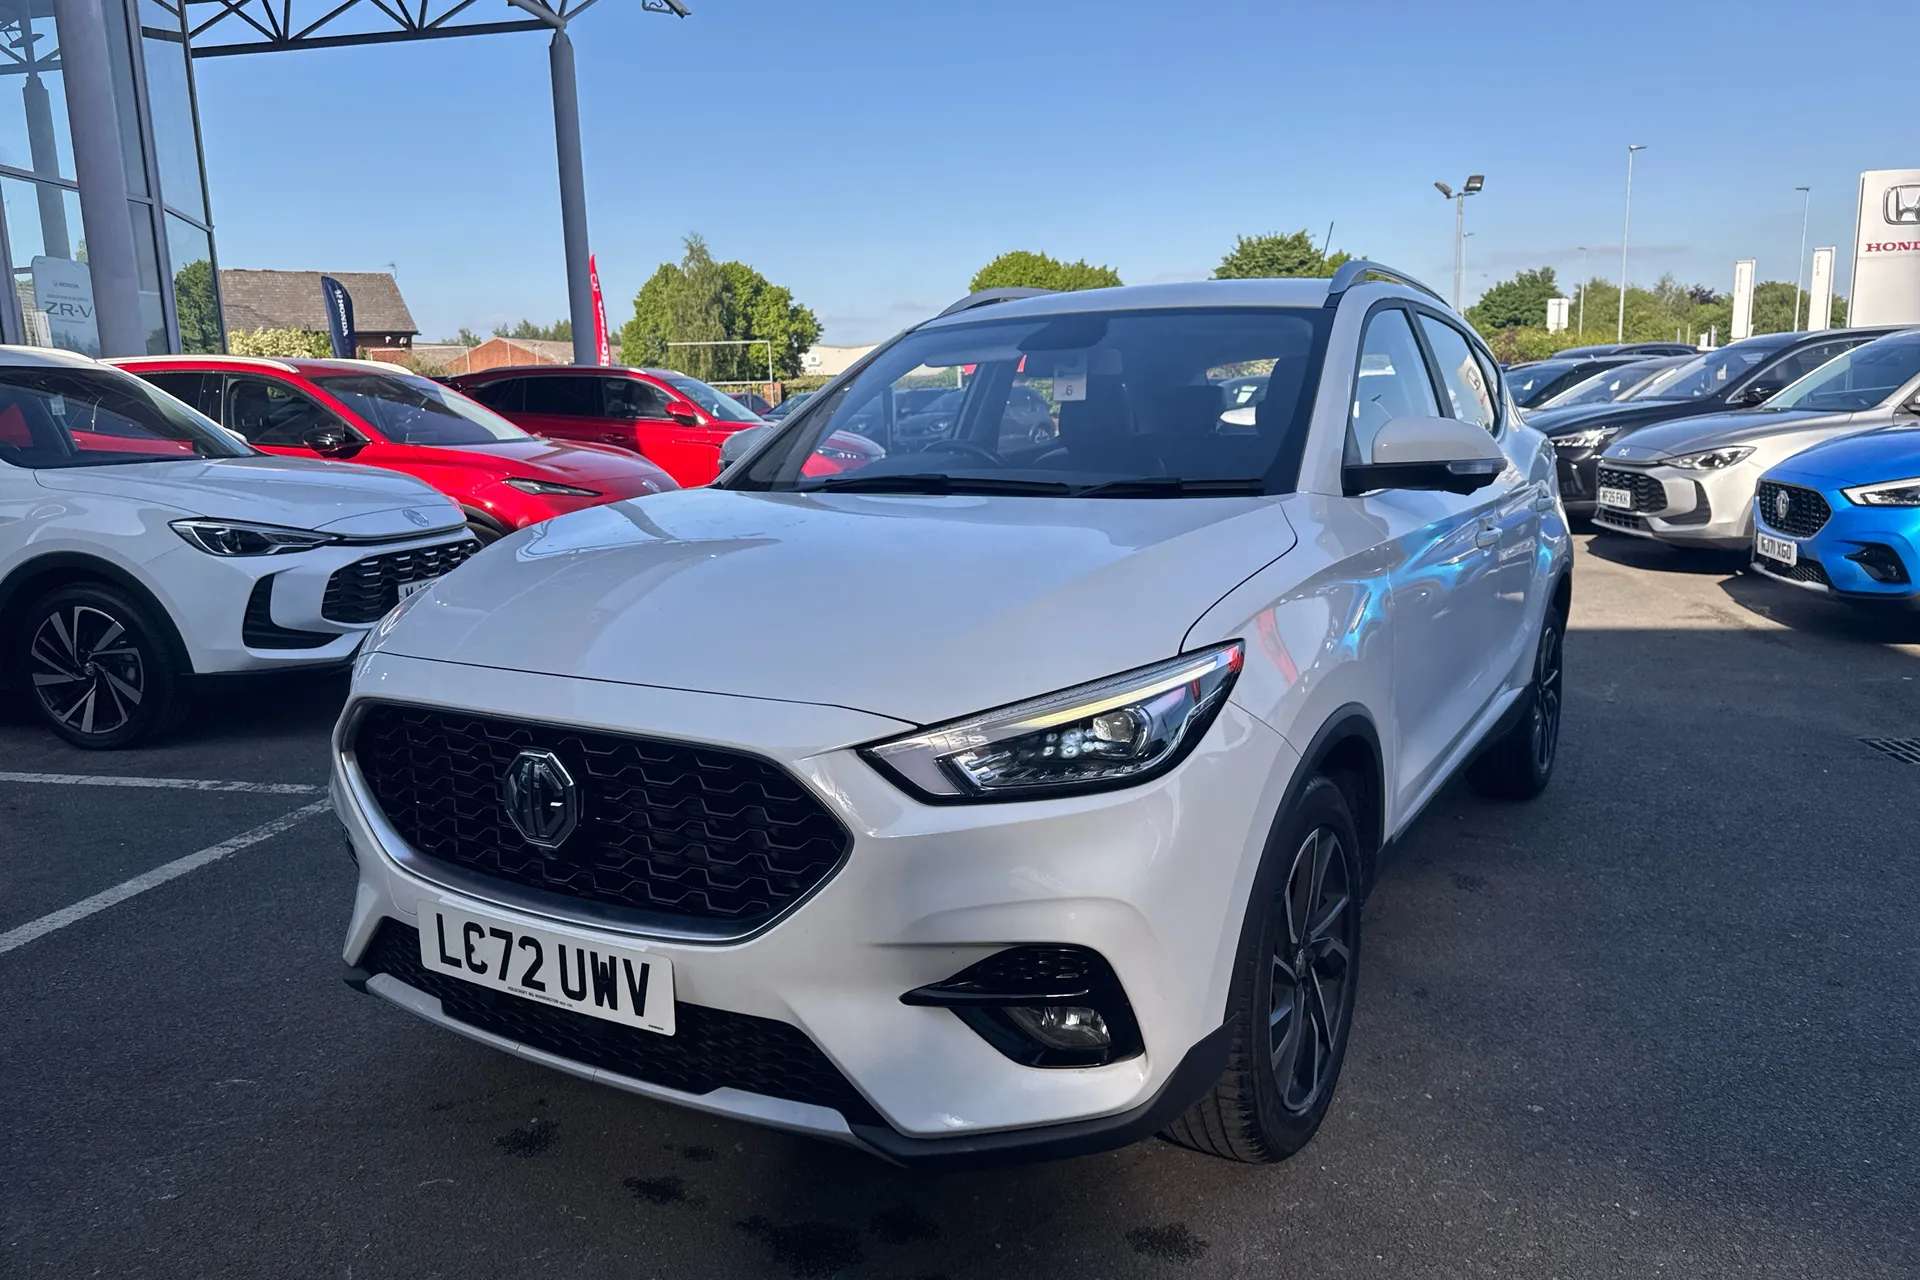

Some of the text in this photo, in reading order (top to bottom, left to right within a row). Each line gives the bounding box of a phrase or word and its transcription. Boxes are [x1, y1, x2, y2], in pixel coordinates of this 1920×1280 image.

[1866, 242, 1920, 252] HOND
[44, 301, 93, 318] ZR-V
[337, 299, 349, 337] HONDA
[517, 757, 567, 840] MG
[558, 944, 650, 1017] UWV
